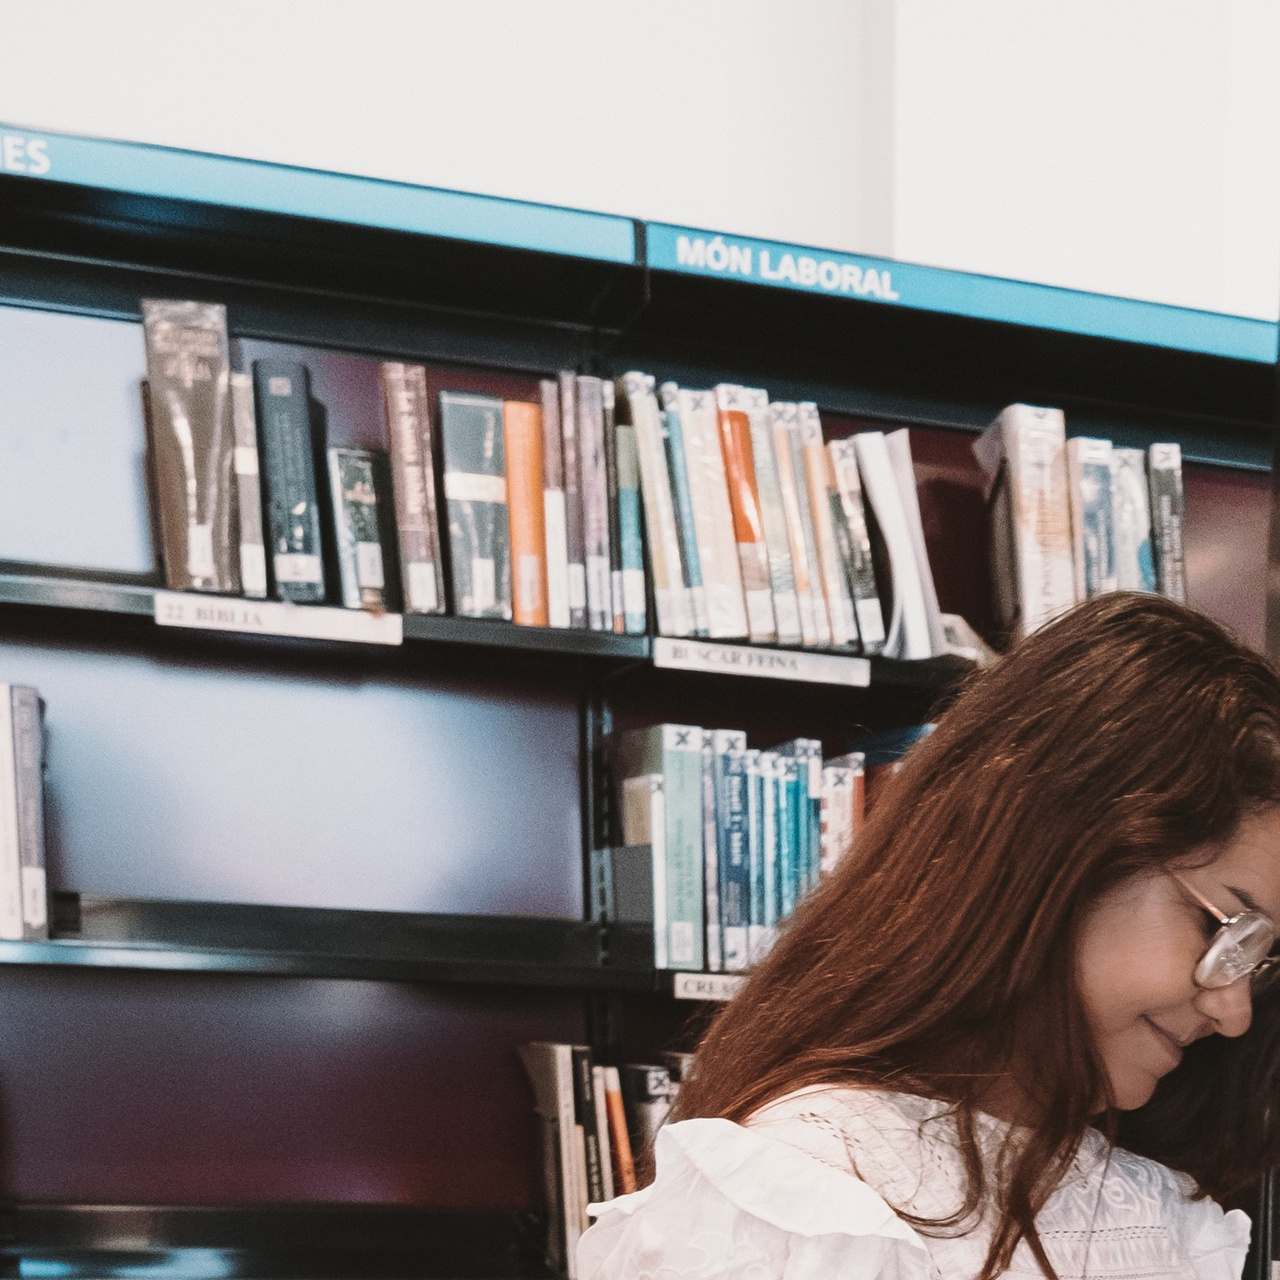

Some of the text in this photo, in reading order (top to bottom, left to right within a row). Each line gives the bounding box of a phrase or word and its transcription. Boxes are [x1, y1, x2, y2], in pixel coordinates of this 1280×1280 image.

[0, 135, 50, 175] ES
[676, 235, 899, 300] MÓN LABORAL
